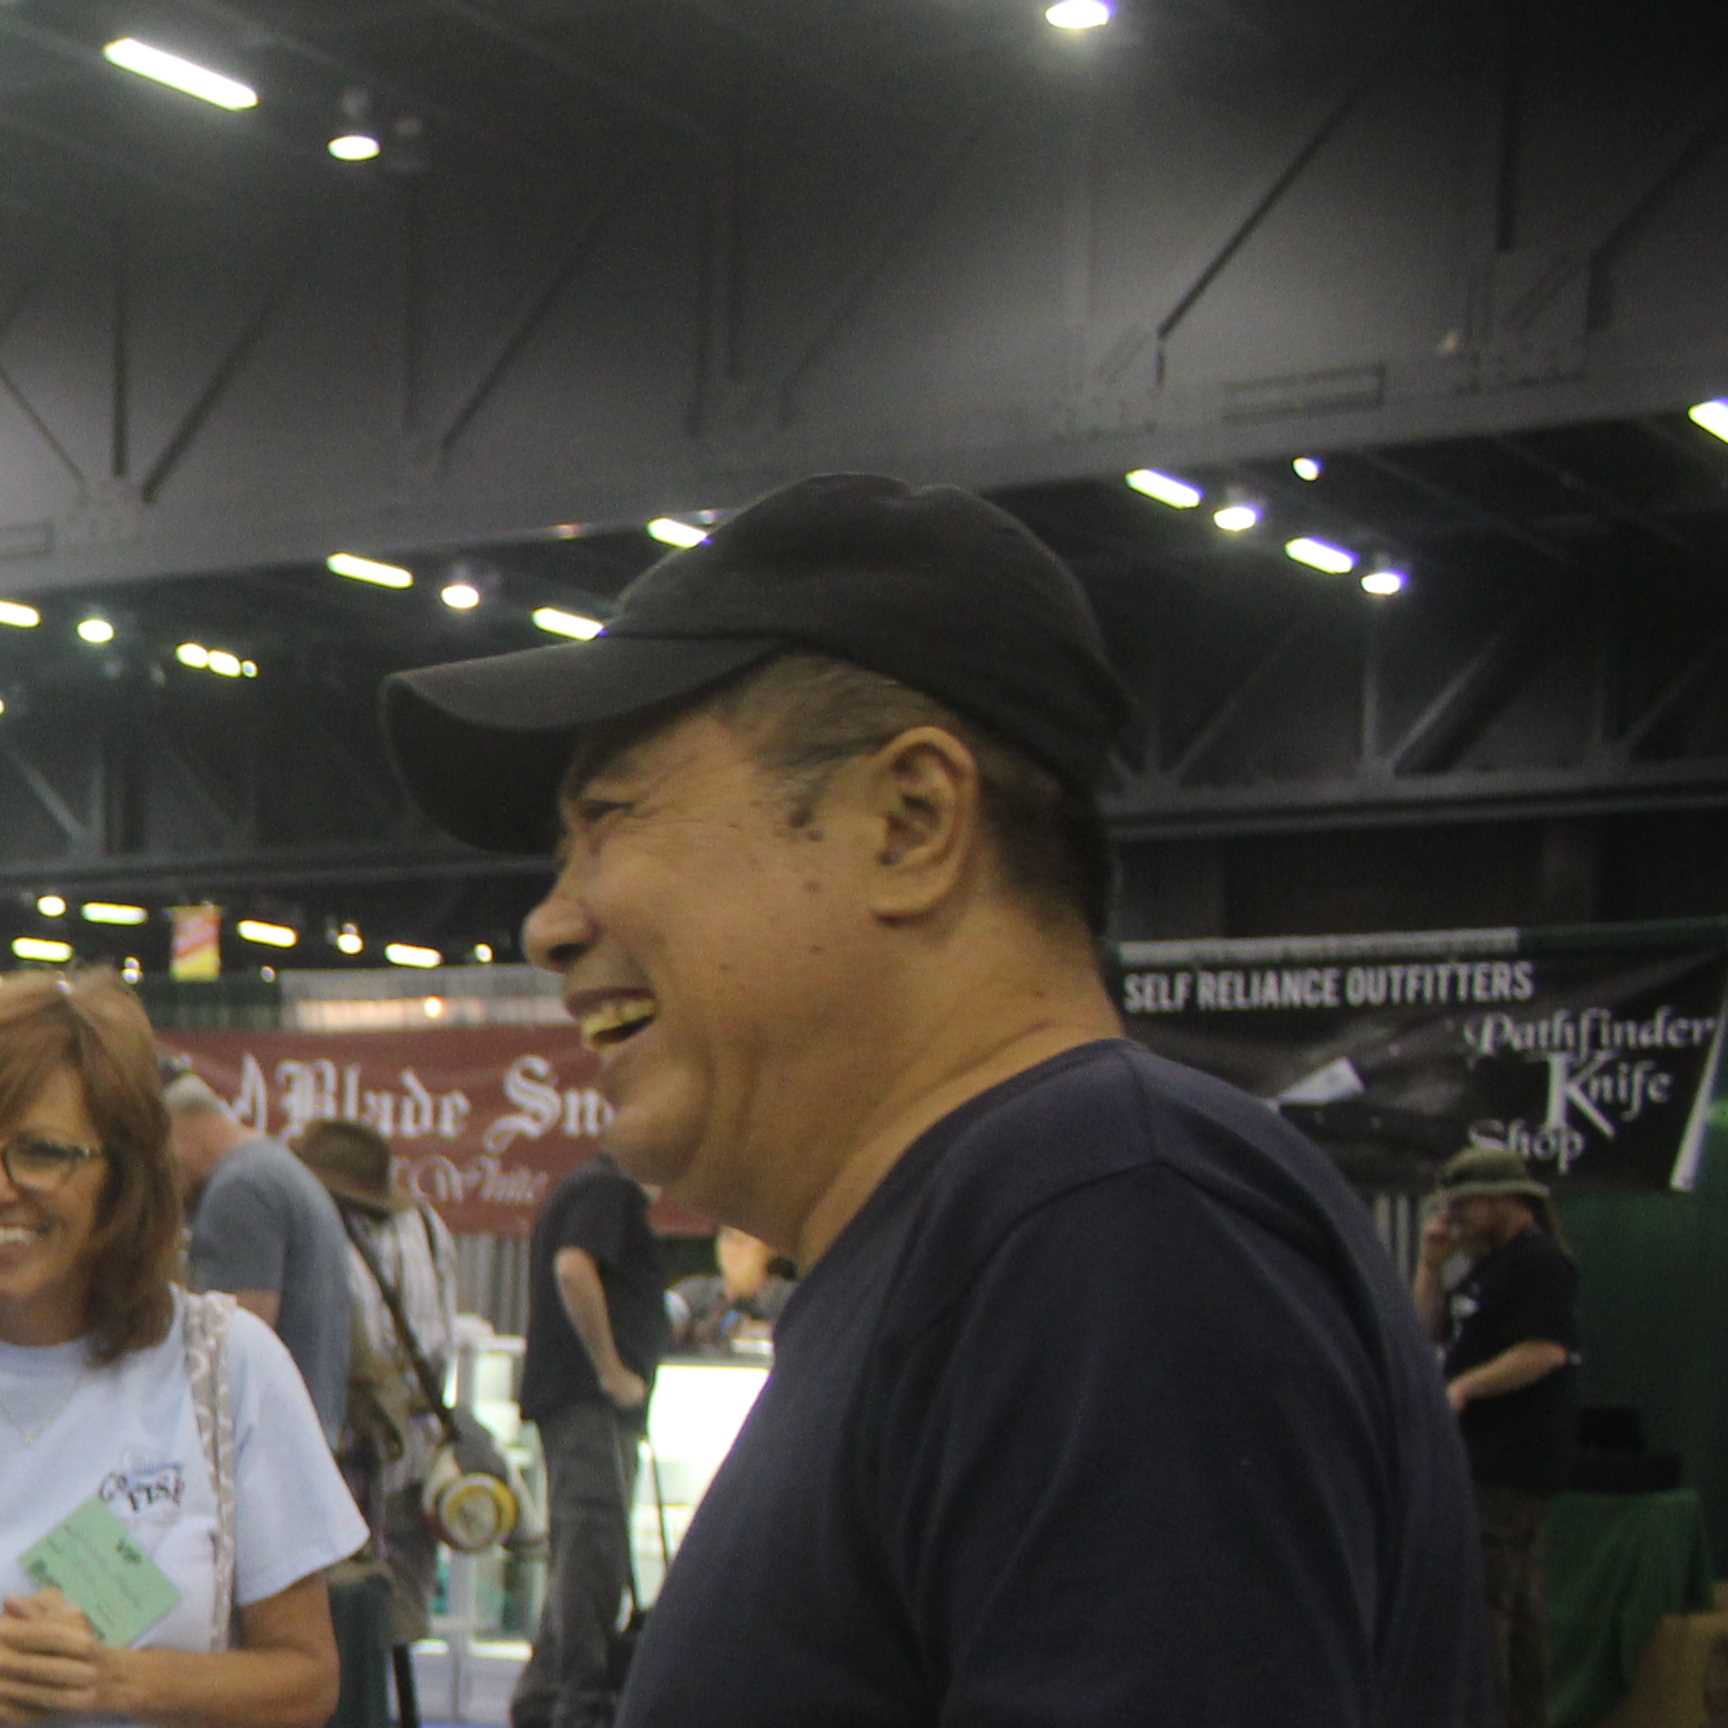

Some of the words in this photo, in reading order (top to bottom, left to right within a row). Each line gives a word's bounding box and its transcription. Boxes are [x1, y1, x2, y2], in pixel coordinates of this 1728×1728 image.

[1122, 971, 1193, 1013] SELF
[1196, 966, 1340, 1010] RELIANCE
[1345, 960, 1535, 1007] OUTFITTERS
[1462, 1006, 1716, 1060] Pathfinder
[276, 1056, 471, 1142] Blade
[1547, 1050, 1673, 1138] Knife
[1468, 1118, 1585, 1175] Shop
